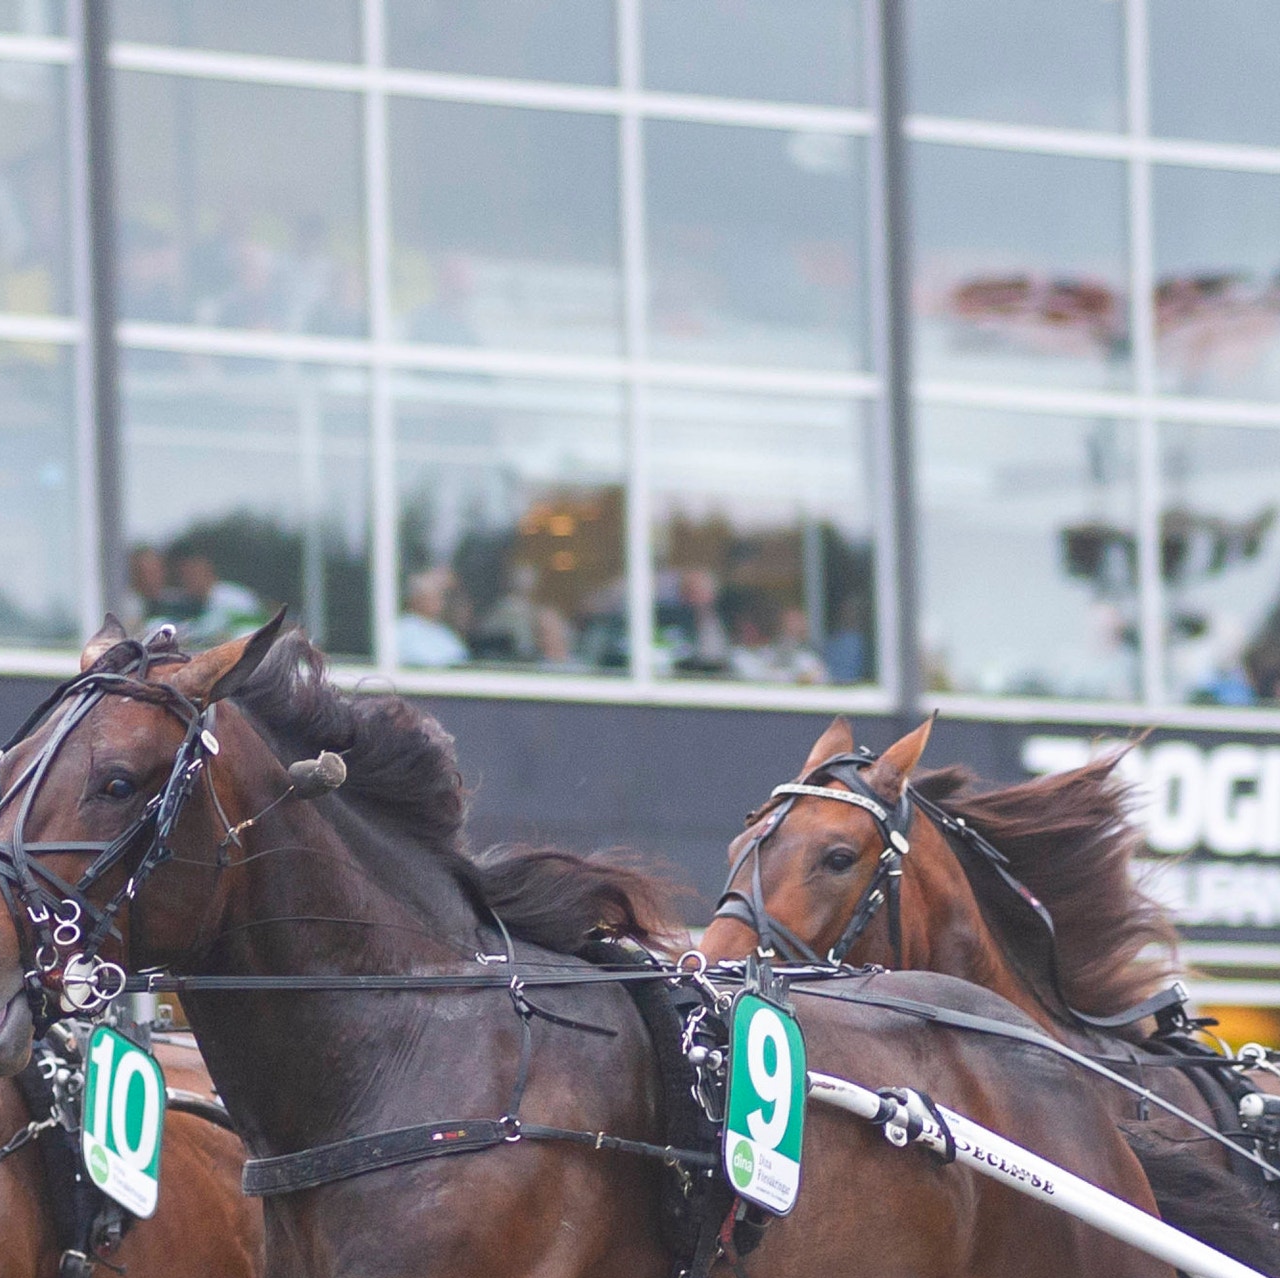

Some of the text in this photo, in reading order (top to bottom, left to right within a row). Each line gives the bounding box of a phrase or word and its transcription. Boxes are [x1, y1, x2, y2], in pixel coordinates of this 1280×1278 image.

[91, 1033, 160, 1171] 10
[746, 1008, 792, 1150] 9
[733, 1153, 753, 1174] dina
